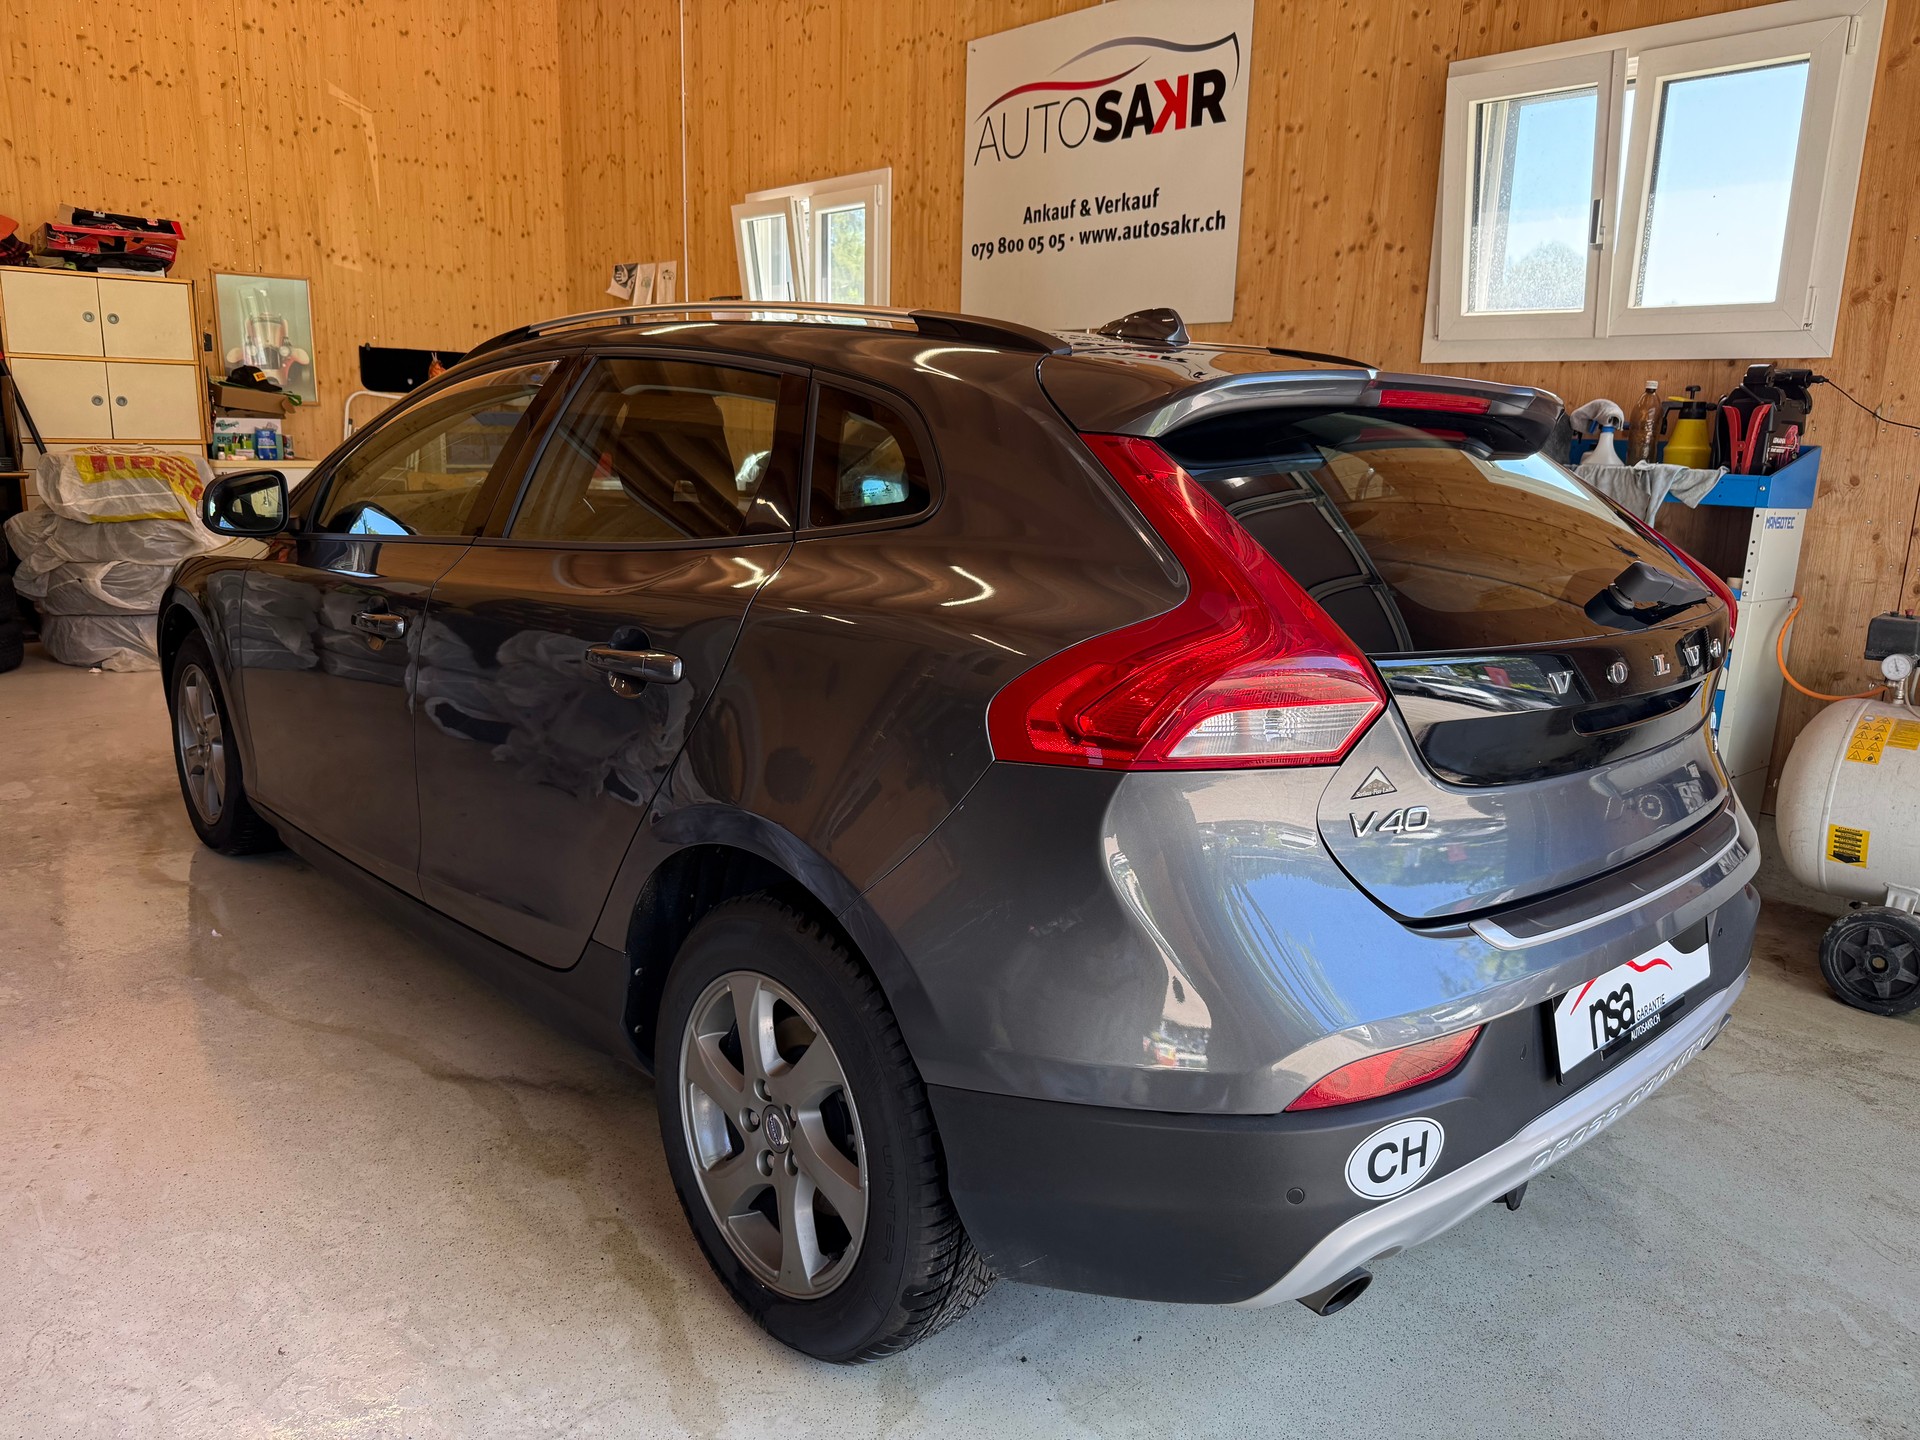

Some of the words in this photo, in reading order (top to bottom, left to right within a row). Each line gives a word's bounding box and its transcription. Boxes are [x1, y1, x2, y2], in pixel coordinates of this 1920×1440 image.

[974, 68, 1226, 166] AUTOSAKR
[1023, 199, 1076, 225] Ankauf
[1079, 199, 1091, 217] &
[1095, 187, 1160, 215] Verkauf
[971, 240, 994, 260] 079
[998, 236, 1024, 254] 800
[1028, 235, 1044, 254] 05
[1049, 232, 1065, 251] 05
[1079, 210, 1226, 246] www.autosakr.ch
[1547, 638, 1721, 694] VOLVO
[1348, 805, 1429, 838] V40
[1589, 982, 1635, 1050] nsa
[1636, 993, 1666, 1021] GARANTIE
[1368, 1130, 1428, 1183] CH
